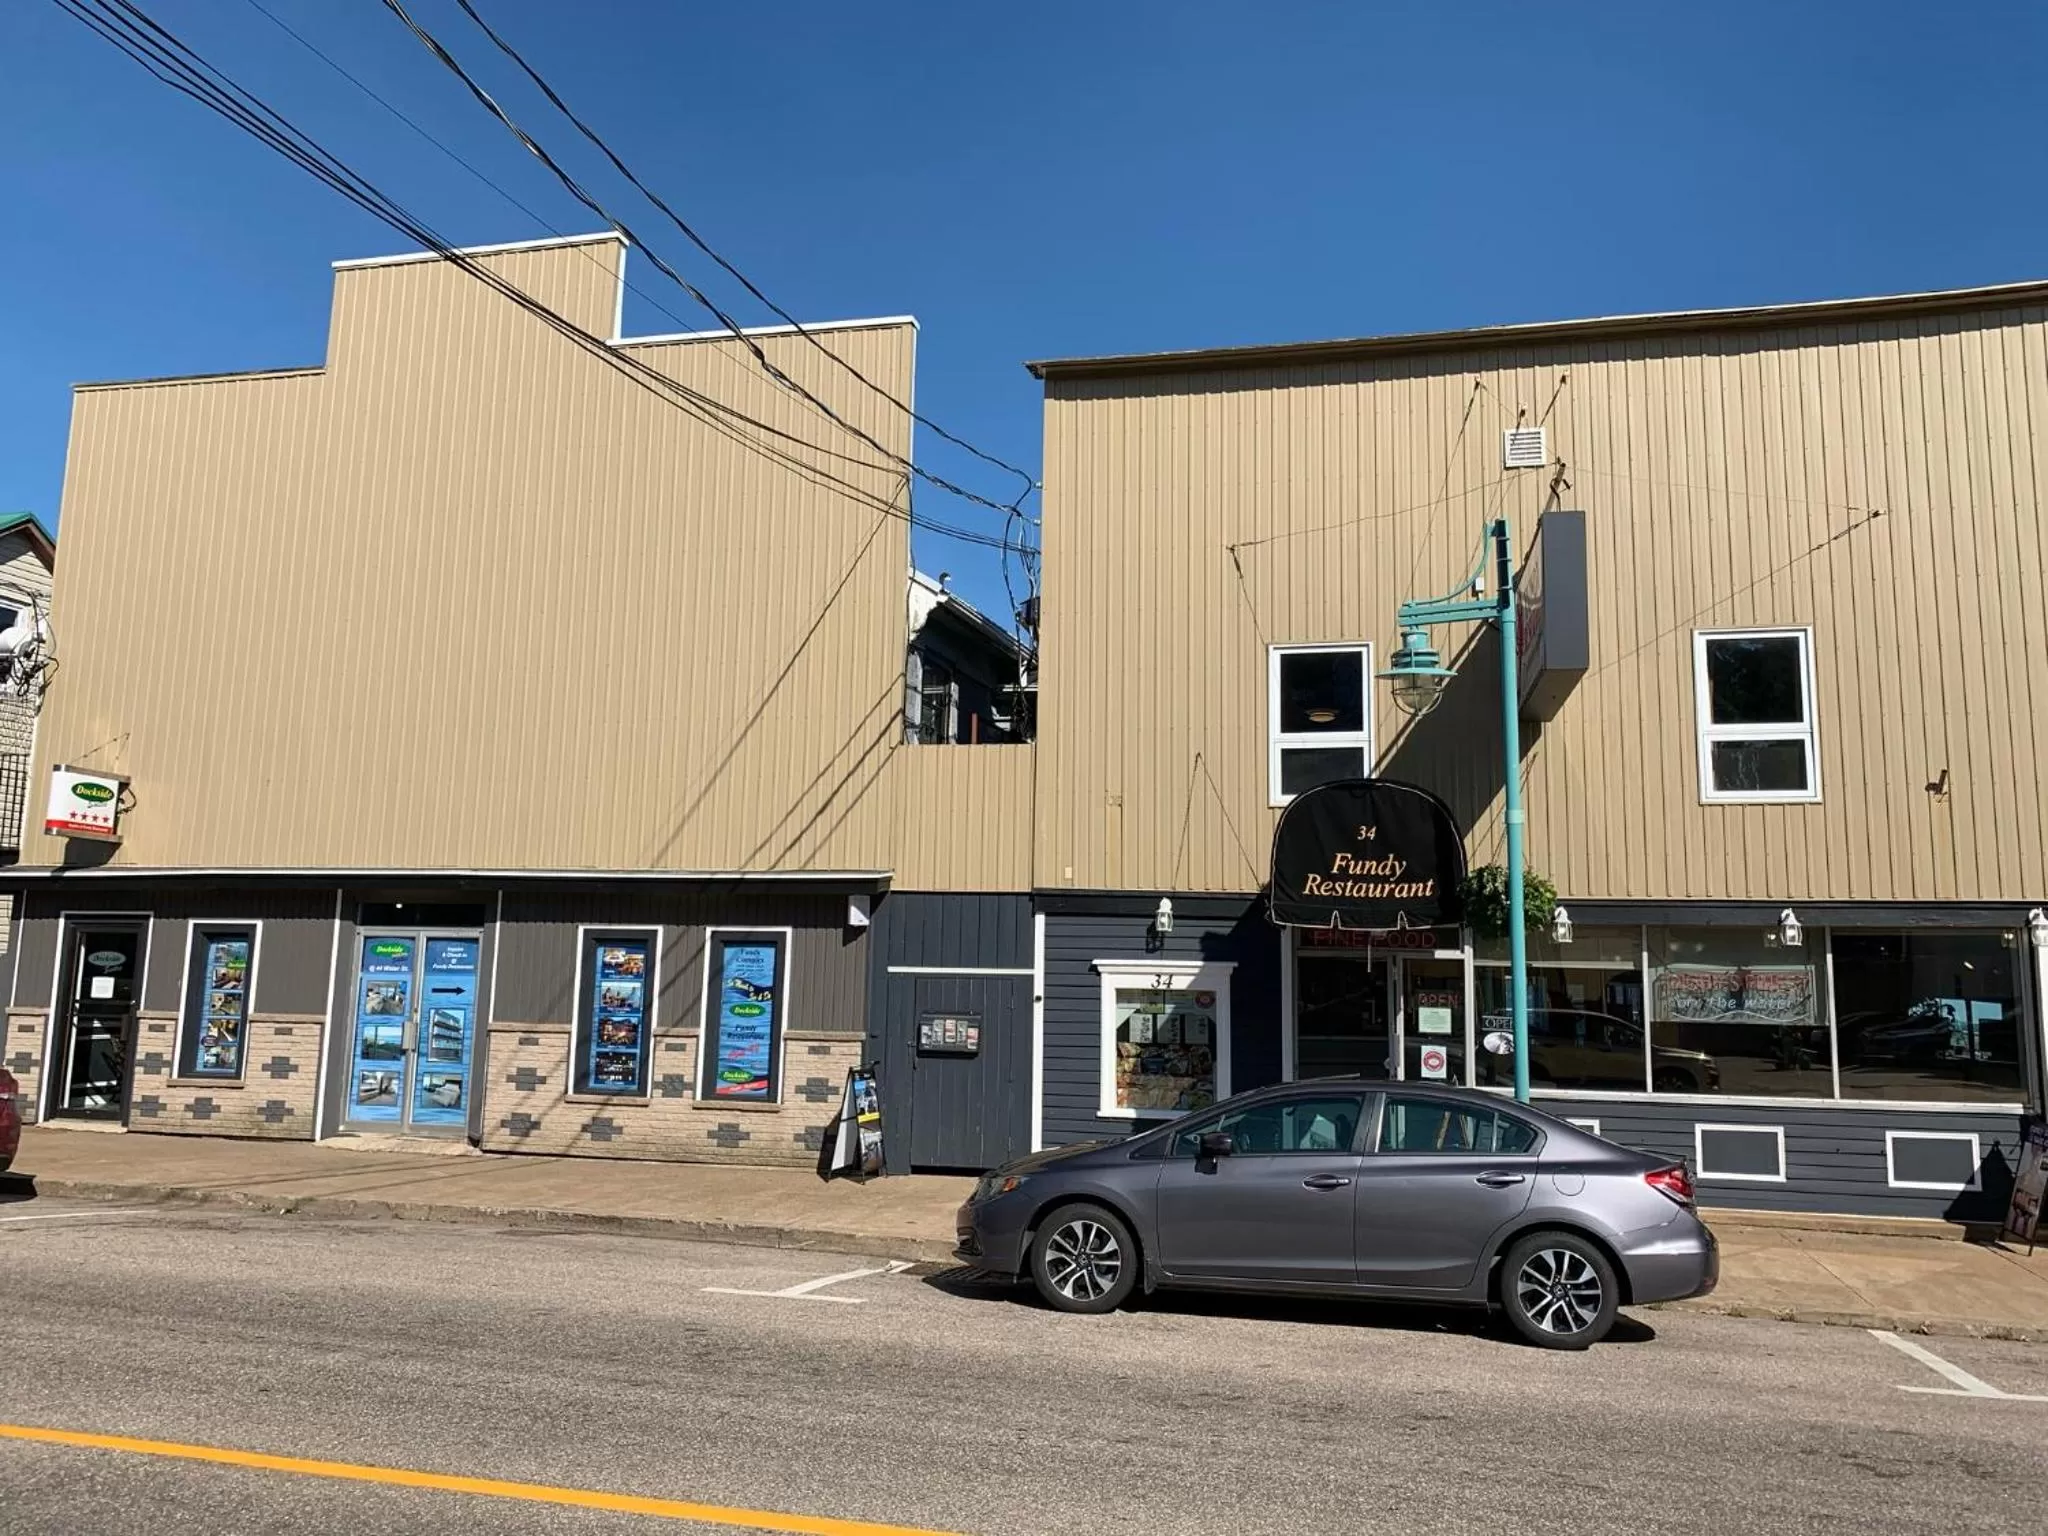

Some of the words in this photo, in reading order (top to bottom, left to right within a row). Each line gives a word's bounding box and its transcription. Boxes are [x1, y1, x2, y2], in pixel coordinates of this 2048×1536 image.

[76, 785, 113, 799] Dockside
[1357, 825, 1377, 840] 34
[1330, 852, 1407, 881] Fundy
[1302, 873, 1435, 898] Restaurant
[1313, 930, 1366, 945] FINE
[1373, 931, 1436, 948] FOOD
[1151, 973, 1174, 989] 34
[1420, 994, 1459, 1007] OPEN
[1708, 996, 1736, 1009] the
